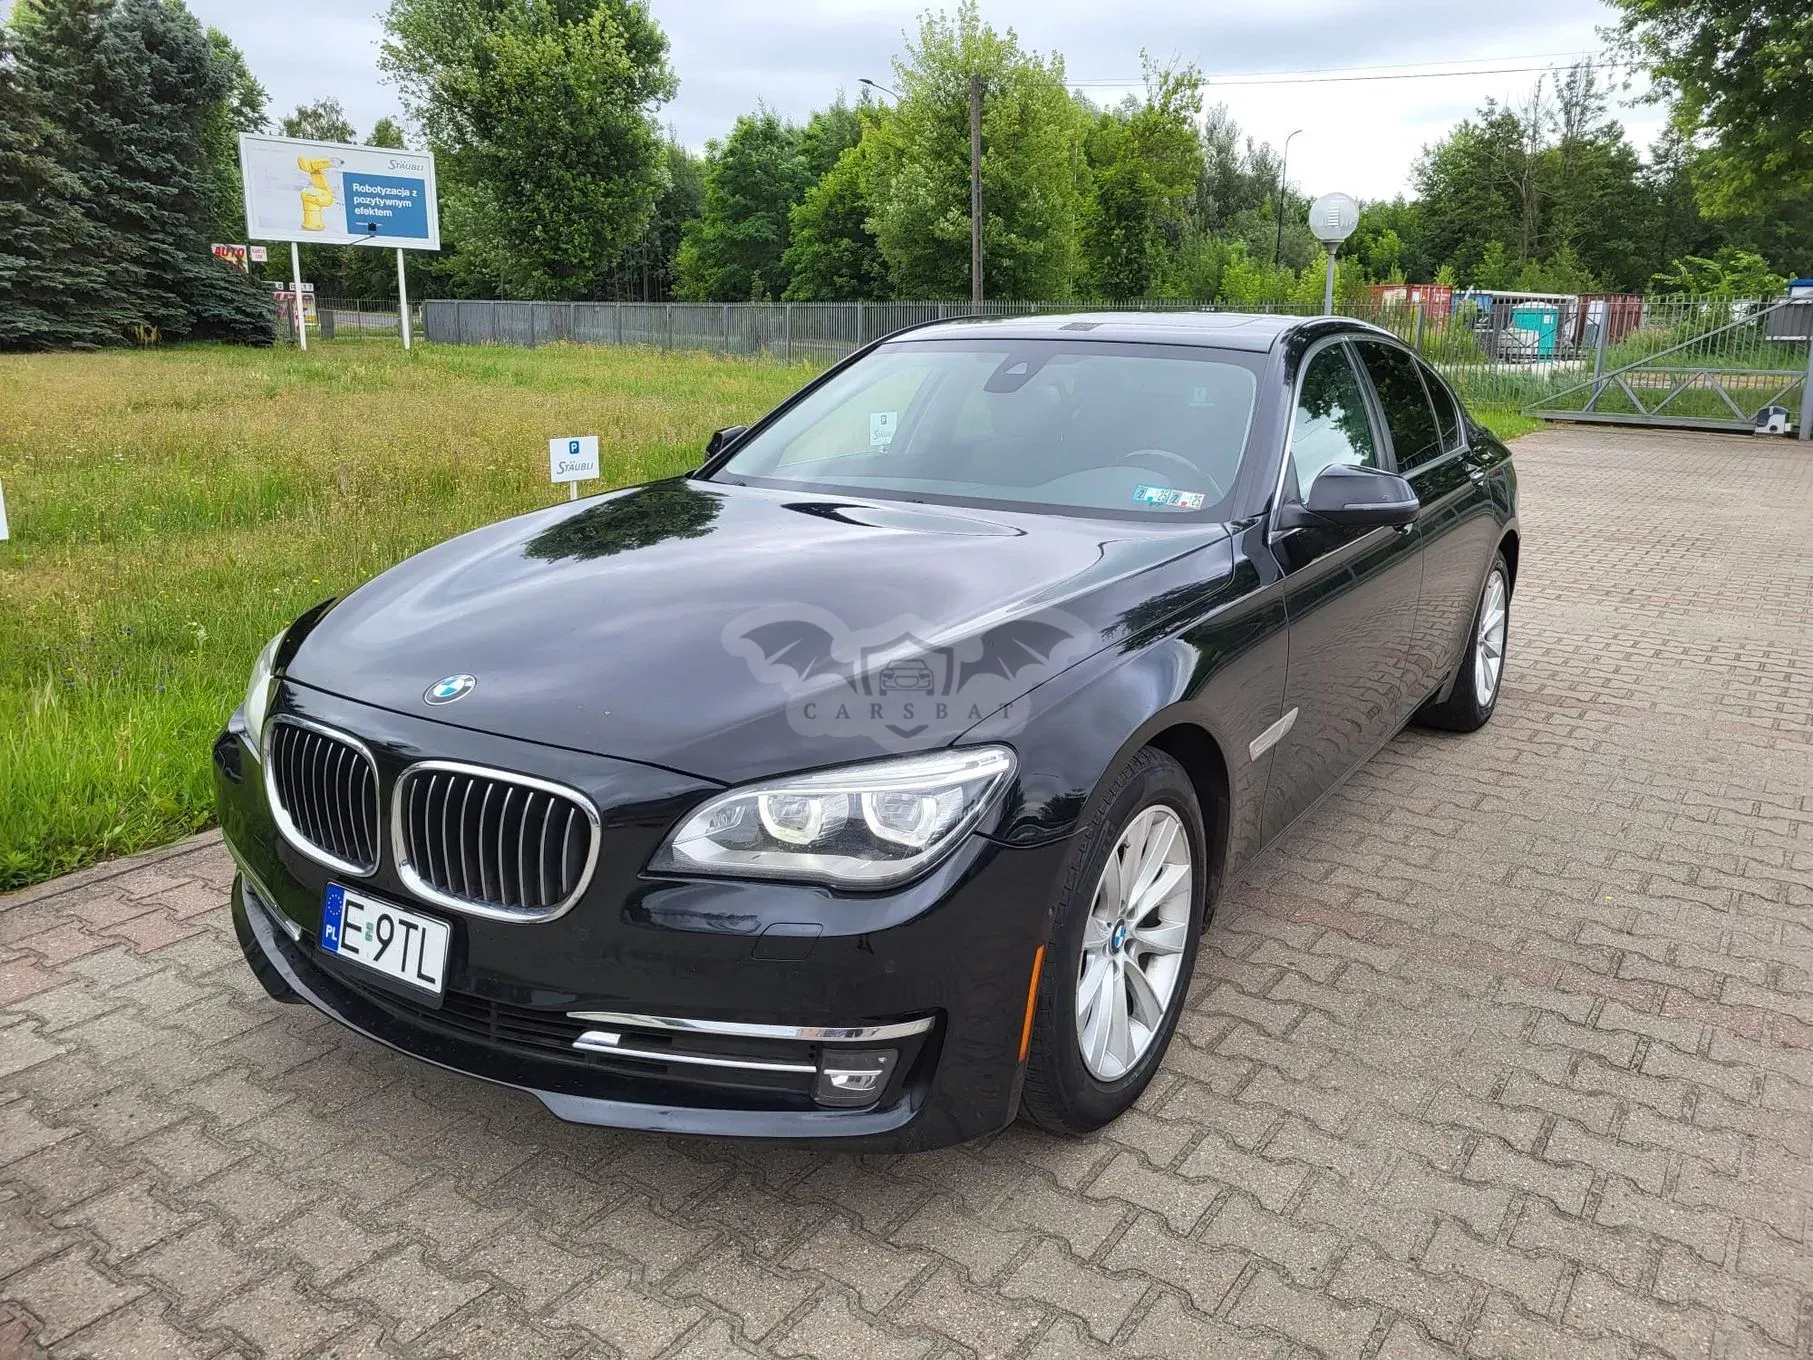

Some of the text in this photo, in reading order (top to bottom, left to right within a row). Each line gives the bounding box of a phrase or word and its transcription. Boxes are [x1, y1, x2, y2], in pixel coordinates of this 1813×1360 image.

[352, 183, 410, 197] Robotyzacja
[353, 196, 412, 208] pozytywnym
[354, 207, 393, 217] efektem
[571, 442, 578, 452] P
[325, 924, 338, 941] PL
